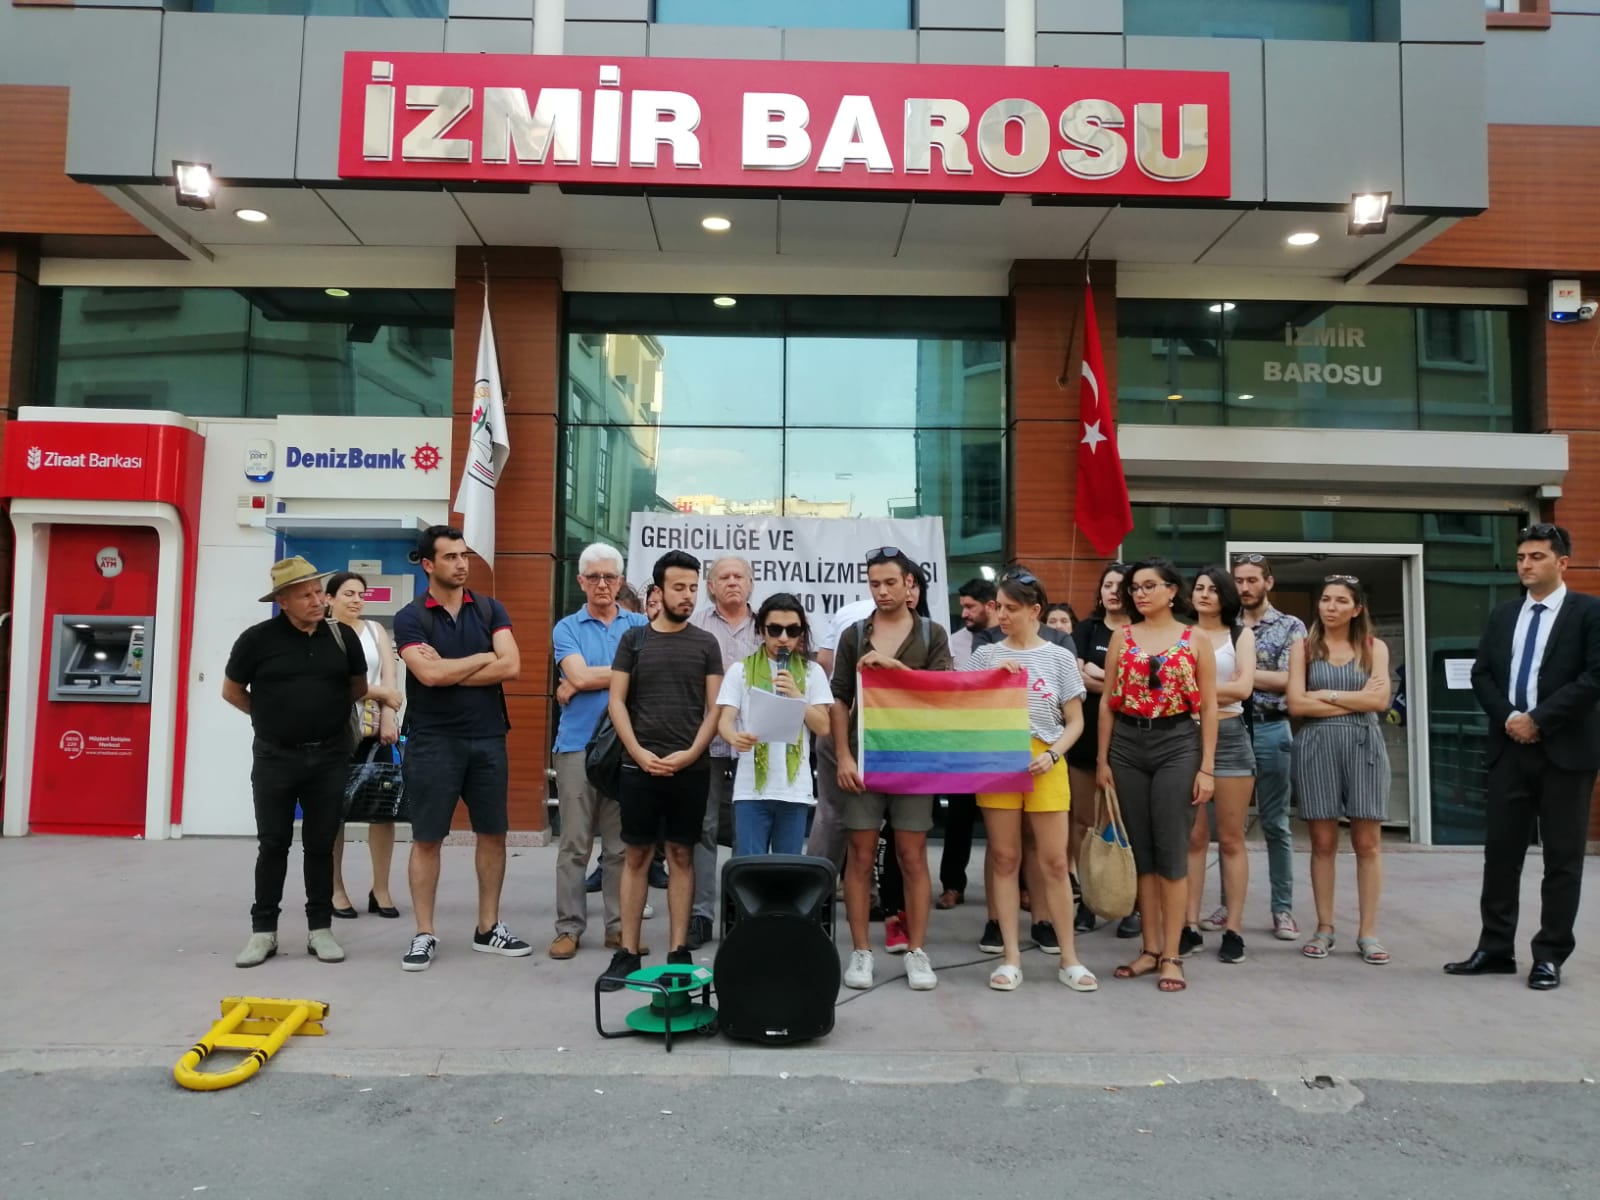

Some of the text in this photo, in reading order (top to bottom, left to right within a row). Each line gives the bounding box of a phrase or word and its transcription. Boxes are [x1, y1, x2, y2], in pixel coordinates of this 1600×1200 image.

[362, 60, 1210, 183] İZMİR BAROSU
[1285, 322, 1366, 349] İZMİR
[1263, 361, 1383, 387] BAROSU
[44, 451, 142, 469] Ziraat Bankası
[286, 446, 406, 470] DenizBank
[641, 523, 794, 552] GERİCİLİĞE VE
[702, 557, 869, 584] EERYALİZME
